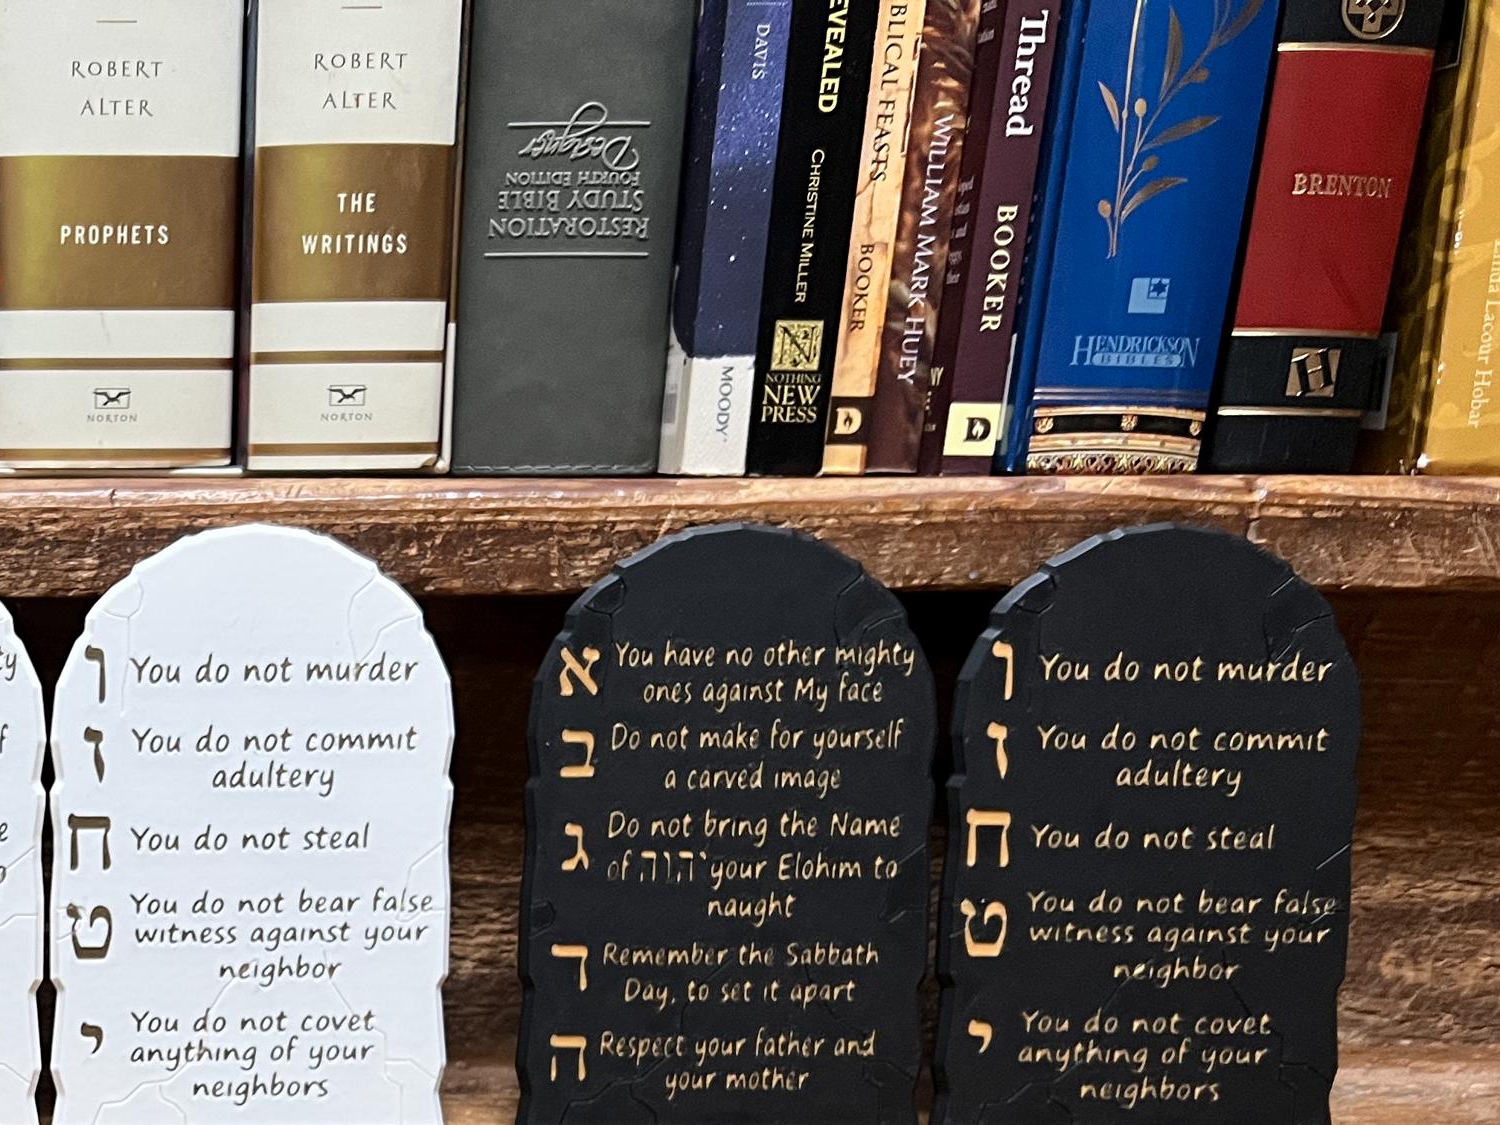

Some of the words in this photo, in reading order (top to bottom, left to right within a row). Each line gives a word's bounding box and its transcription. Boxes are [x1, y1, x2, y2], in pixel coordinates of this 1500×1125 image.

[313, 52, 408, 72] ROBERT
[751, 24, 771, 80] DAVIS
[72, 60, 163, 79] ROBERT
[1005, 9, 1049, 137] Thread
[80, 97, 154, 117] ALTER
[322, 91, 397, 110] ALTER
[518, 101, 640, 171] Designer
[869, 99, 896, 182] FEASTS
[505, 171, 572, 187] EDITION
[577, 171, 641, 187] FOURTH
[918, 113, 954, 227] WILLIAM
[1292, 173, 1392, 198] BRENTON
[337, 192, 376, 213] THE
[498, 190, 560, 212] BIBLE
[566, 190, 644, 213] STUDY
[801, 149, 825, 239] CHRISTINE
[60, 224, 170, 245] PROPHETS
[301, 233, 408, 255] WRITINGS
[488, 217, 650, 239] RESTORATION
[794, 242, 814, 303] MILLER
[907, 234, 936, 308] MARK
[979, 203, 1019, 333] BOOKER
[850, 244, 875, 332] BOOKER
[1476, 300, 1500, 365] Lacour
[897, 316, 925, 385] HUEY
[1069, 335, 1200, 368] HENDRICKSON
[765, 373, 822, 384] NOTHING
[762, 384, 821, 406] NEW
[1468, 369, 1493, 429] Hobar
[86, 413, 138, 423] NORTON
[320, 412, 372, 422] NORTON
[761, 406, 817, 423] PRESS
[560, 647, 600, 696] א
[616, 642, 652, 667] You
[665, 640, 714, 666] have
[727, 648, 752, 666] no
[764, 640, 825, 666] other
[836, 640, 914, 676] mighty
[644, 683, 691, 703] ones
[703, 679, 783, 712] against
[795, 678, 827, 712] My
[840, 671, 882, 702] face
[68, 814, 111, 870] ח
[131, 827, 178, 851] You
[195, 824, 227, 850] do
[243, 828, 290, 849] not
[304, 823, 369, 850] steal
[130, 893, 176, 914] You
[192, 891, 224, 914] do
[239, 894, 284, 913] not
[299, 889, 360, 913] bear
[373, 887, 432, 912] false
[67, 903, 112, 959] ט
[135, 924, 236, 944] witness
[251, 922, 350, 951] against
[365, 926, 428, 950] your
[220, 955, 341, 987] neighbor
[969, 1020, 992, 1053] י
[1023, 1011, 1068, 1032] You
[1084, 1008, 1118, 1033] do
[1133, 1014, 1180, 1033] not
[1195, 1014, 1270, 1034] covet
[1019, 1040, 1147, 1072] anything
[1162, 1038, 1190, 1063] of
[1202, 1049, 1267, 1073] your
[1081, 1076, 1218, 1108] neighbors
